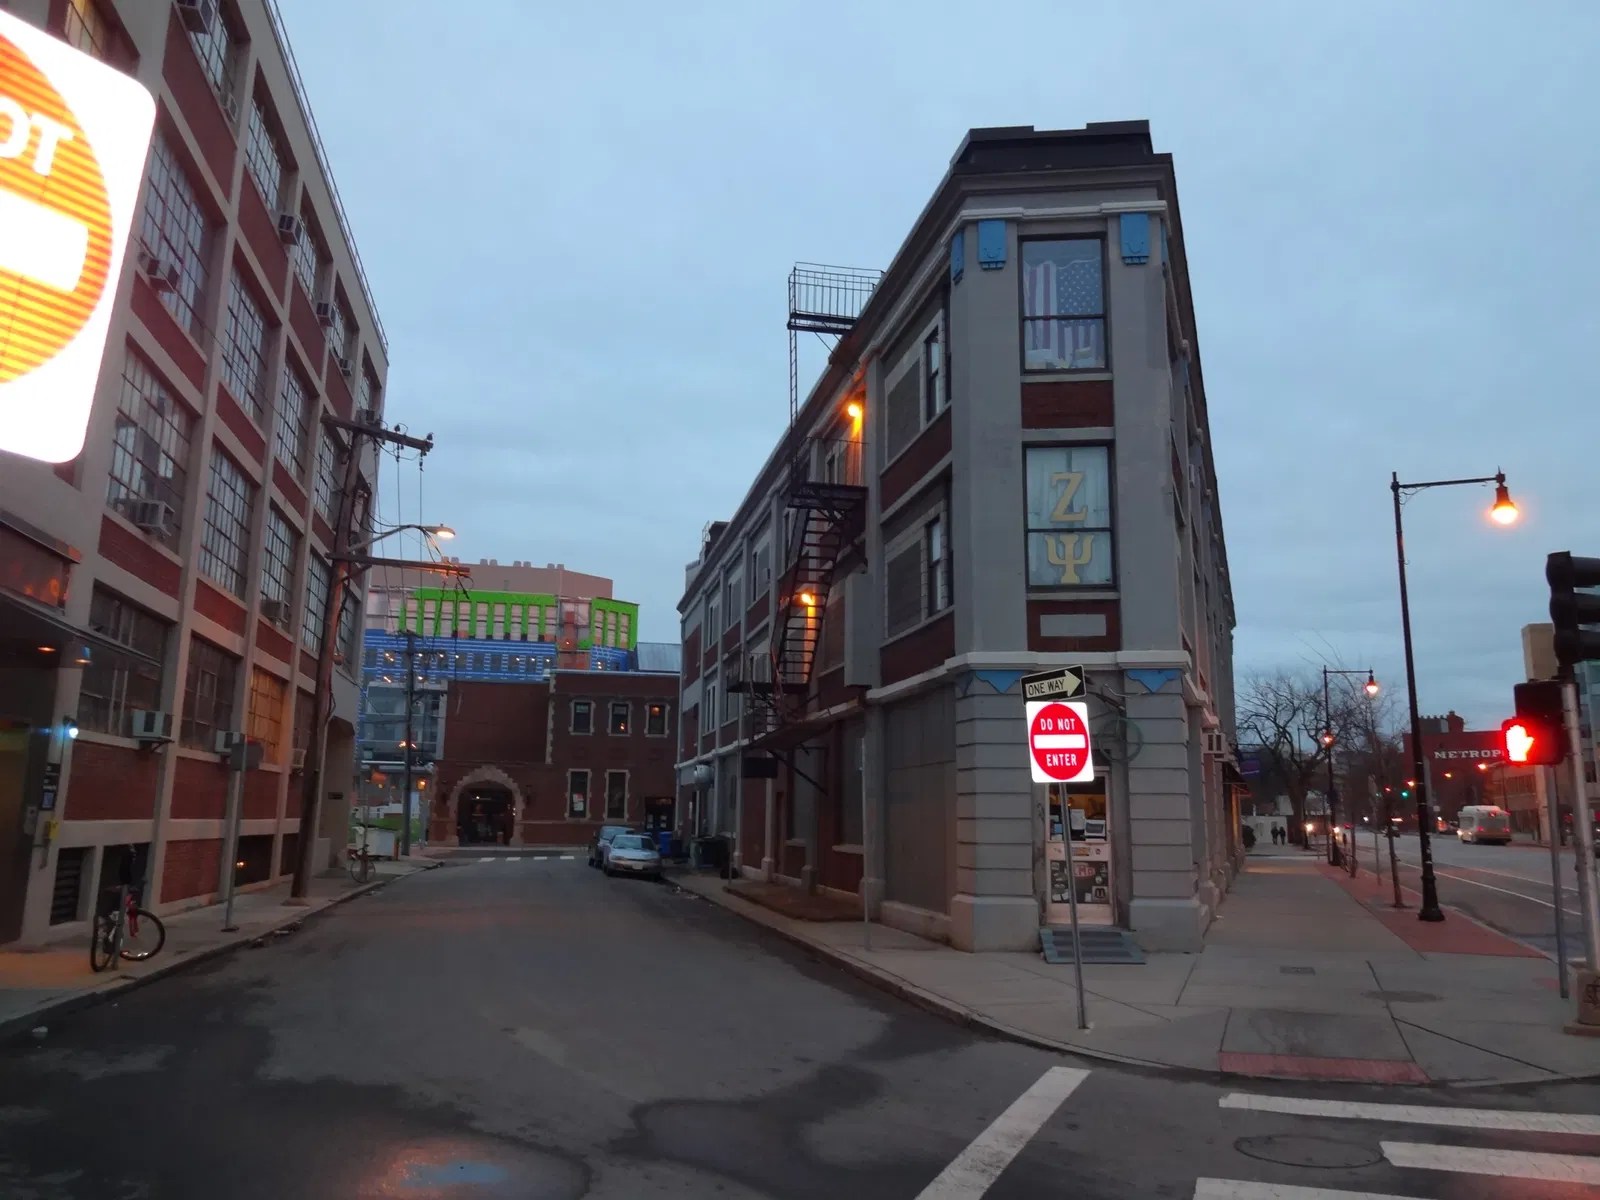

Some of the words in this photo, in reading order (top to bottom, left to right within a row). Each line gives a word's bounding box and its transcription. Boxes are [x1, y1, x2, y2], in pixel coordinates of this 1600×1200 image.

[1046, 535, 1094, 583] Ψ
[1028, 683, 1045, 695] ONE
[1048, 679, 1064, 691] WAY
[1041, 719, 1053, 730] DO
[1058, 719, 1074, 730] NOT
[1046, 754, 1077, 766] ENTER
[1434, 750, 1504, 759] METROP
